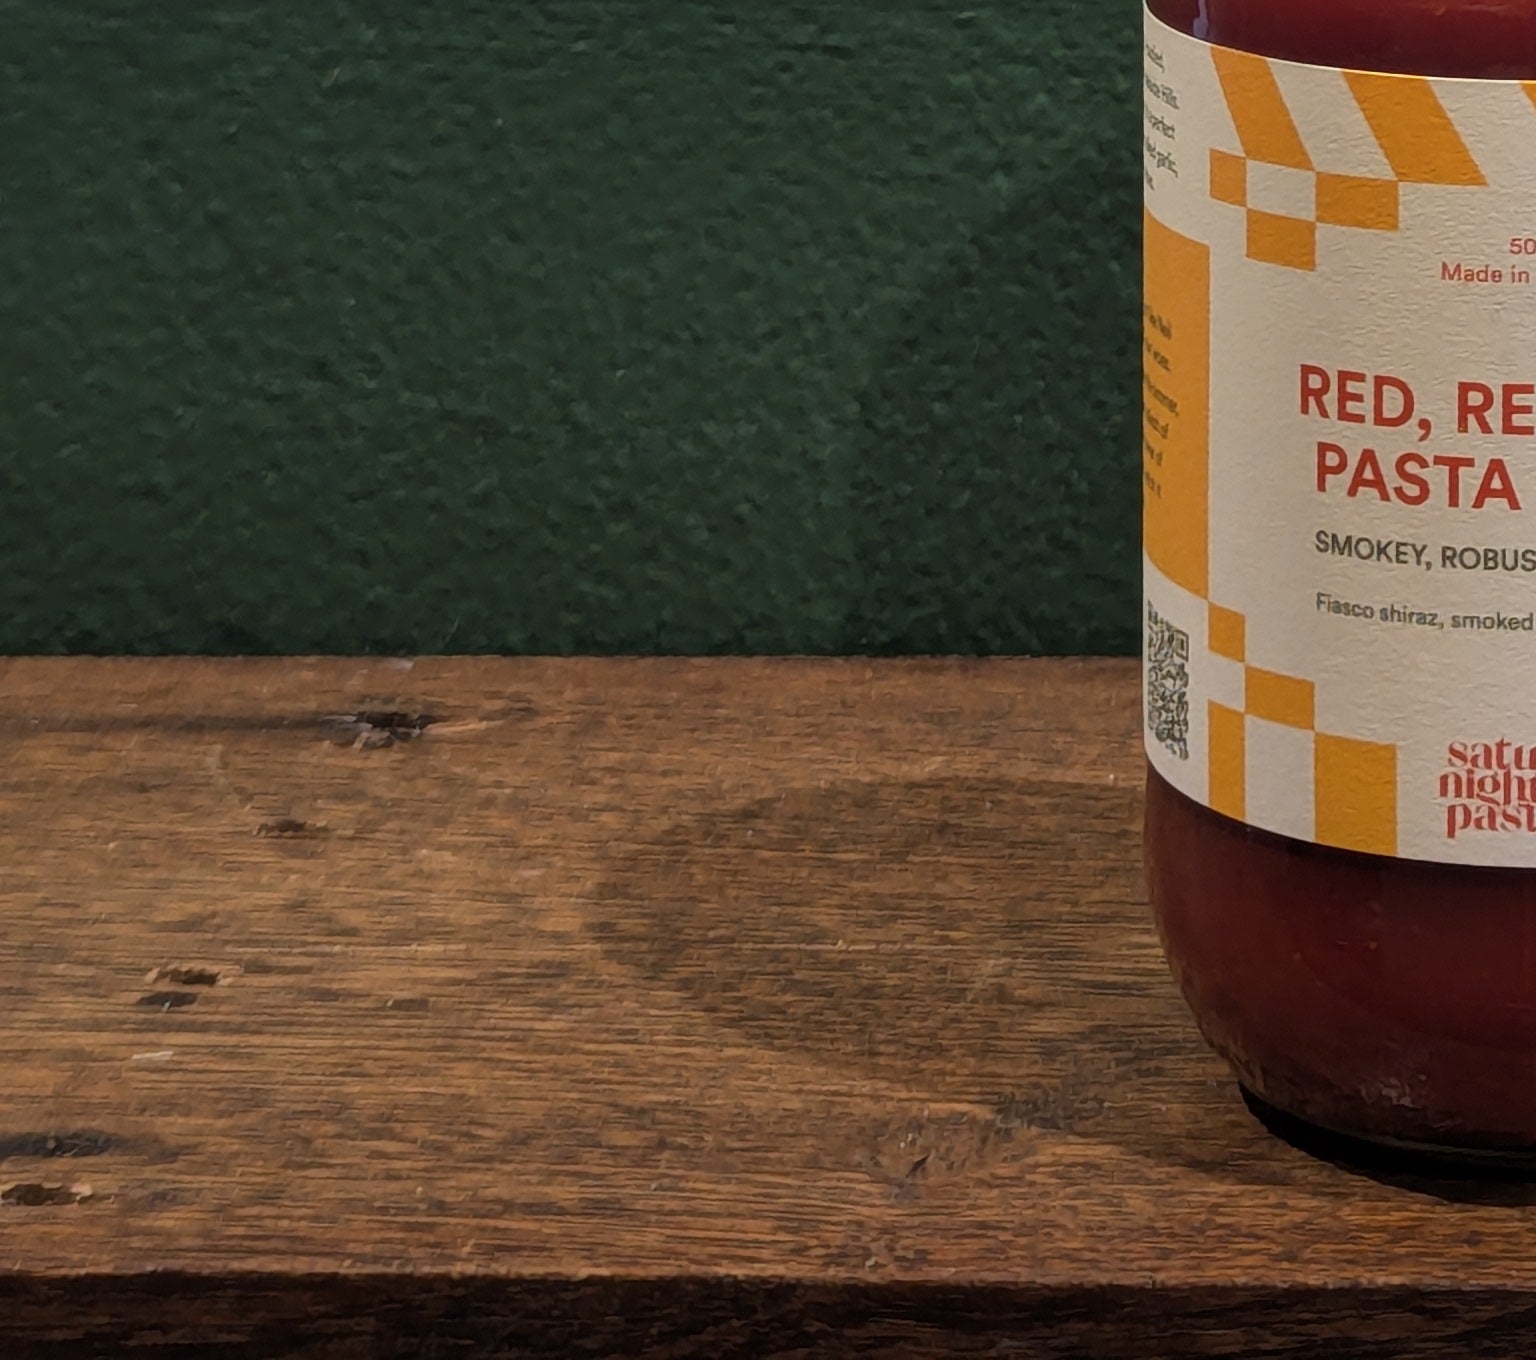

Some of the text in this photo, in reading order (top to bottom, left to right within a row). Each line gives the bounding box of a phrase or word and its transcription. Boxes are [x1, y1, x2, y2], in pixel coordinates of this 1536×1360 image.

[1440, 261, 1503, 283] Made
[1510, 264, 1530, 284] in
[1300, 363, 1432, 442] RED,
[1316, 441, 1522, 510] PASTA
[1315, 530, 1433, 571] SMOKEY,
[1316, 592, 1374, 621] Fiasco
[1379, 603, 1445, 630] shiraz,
[1451, 612, 1534, 632] smoked
